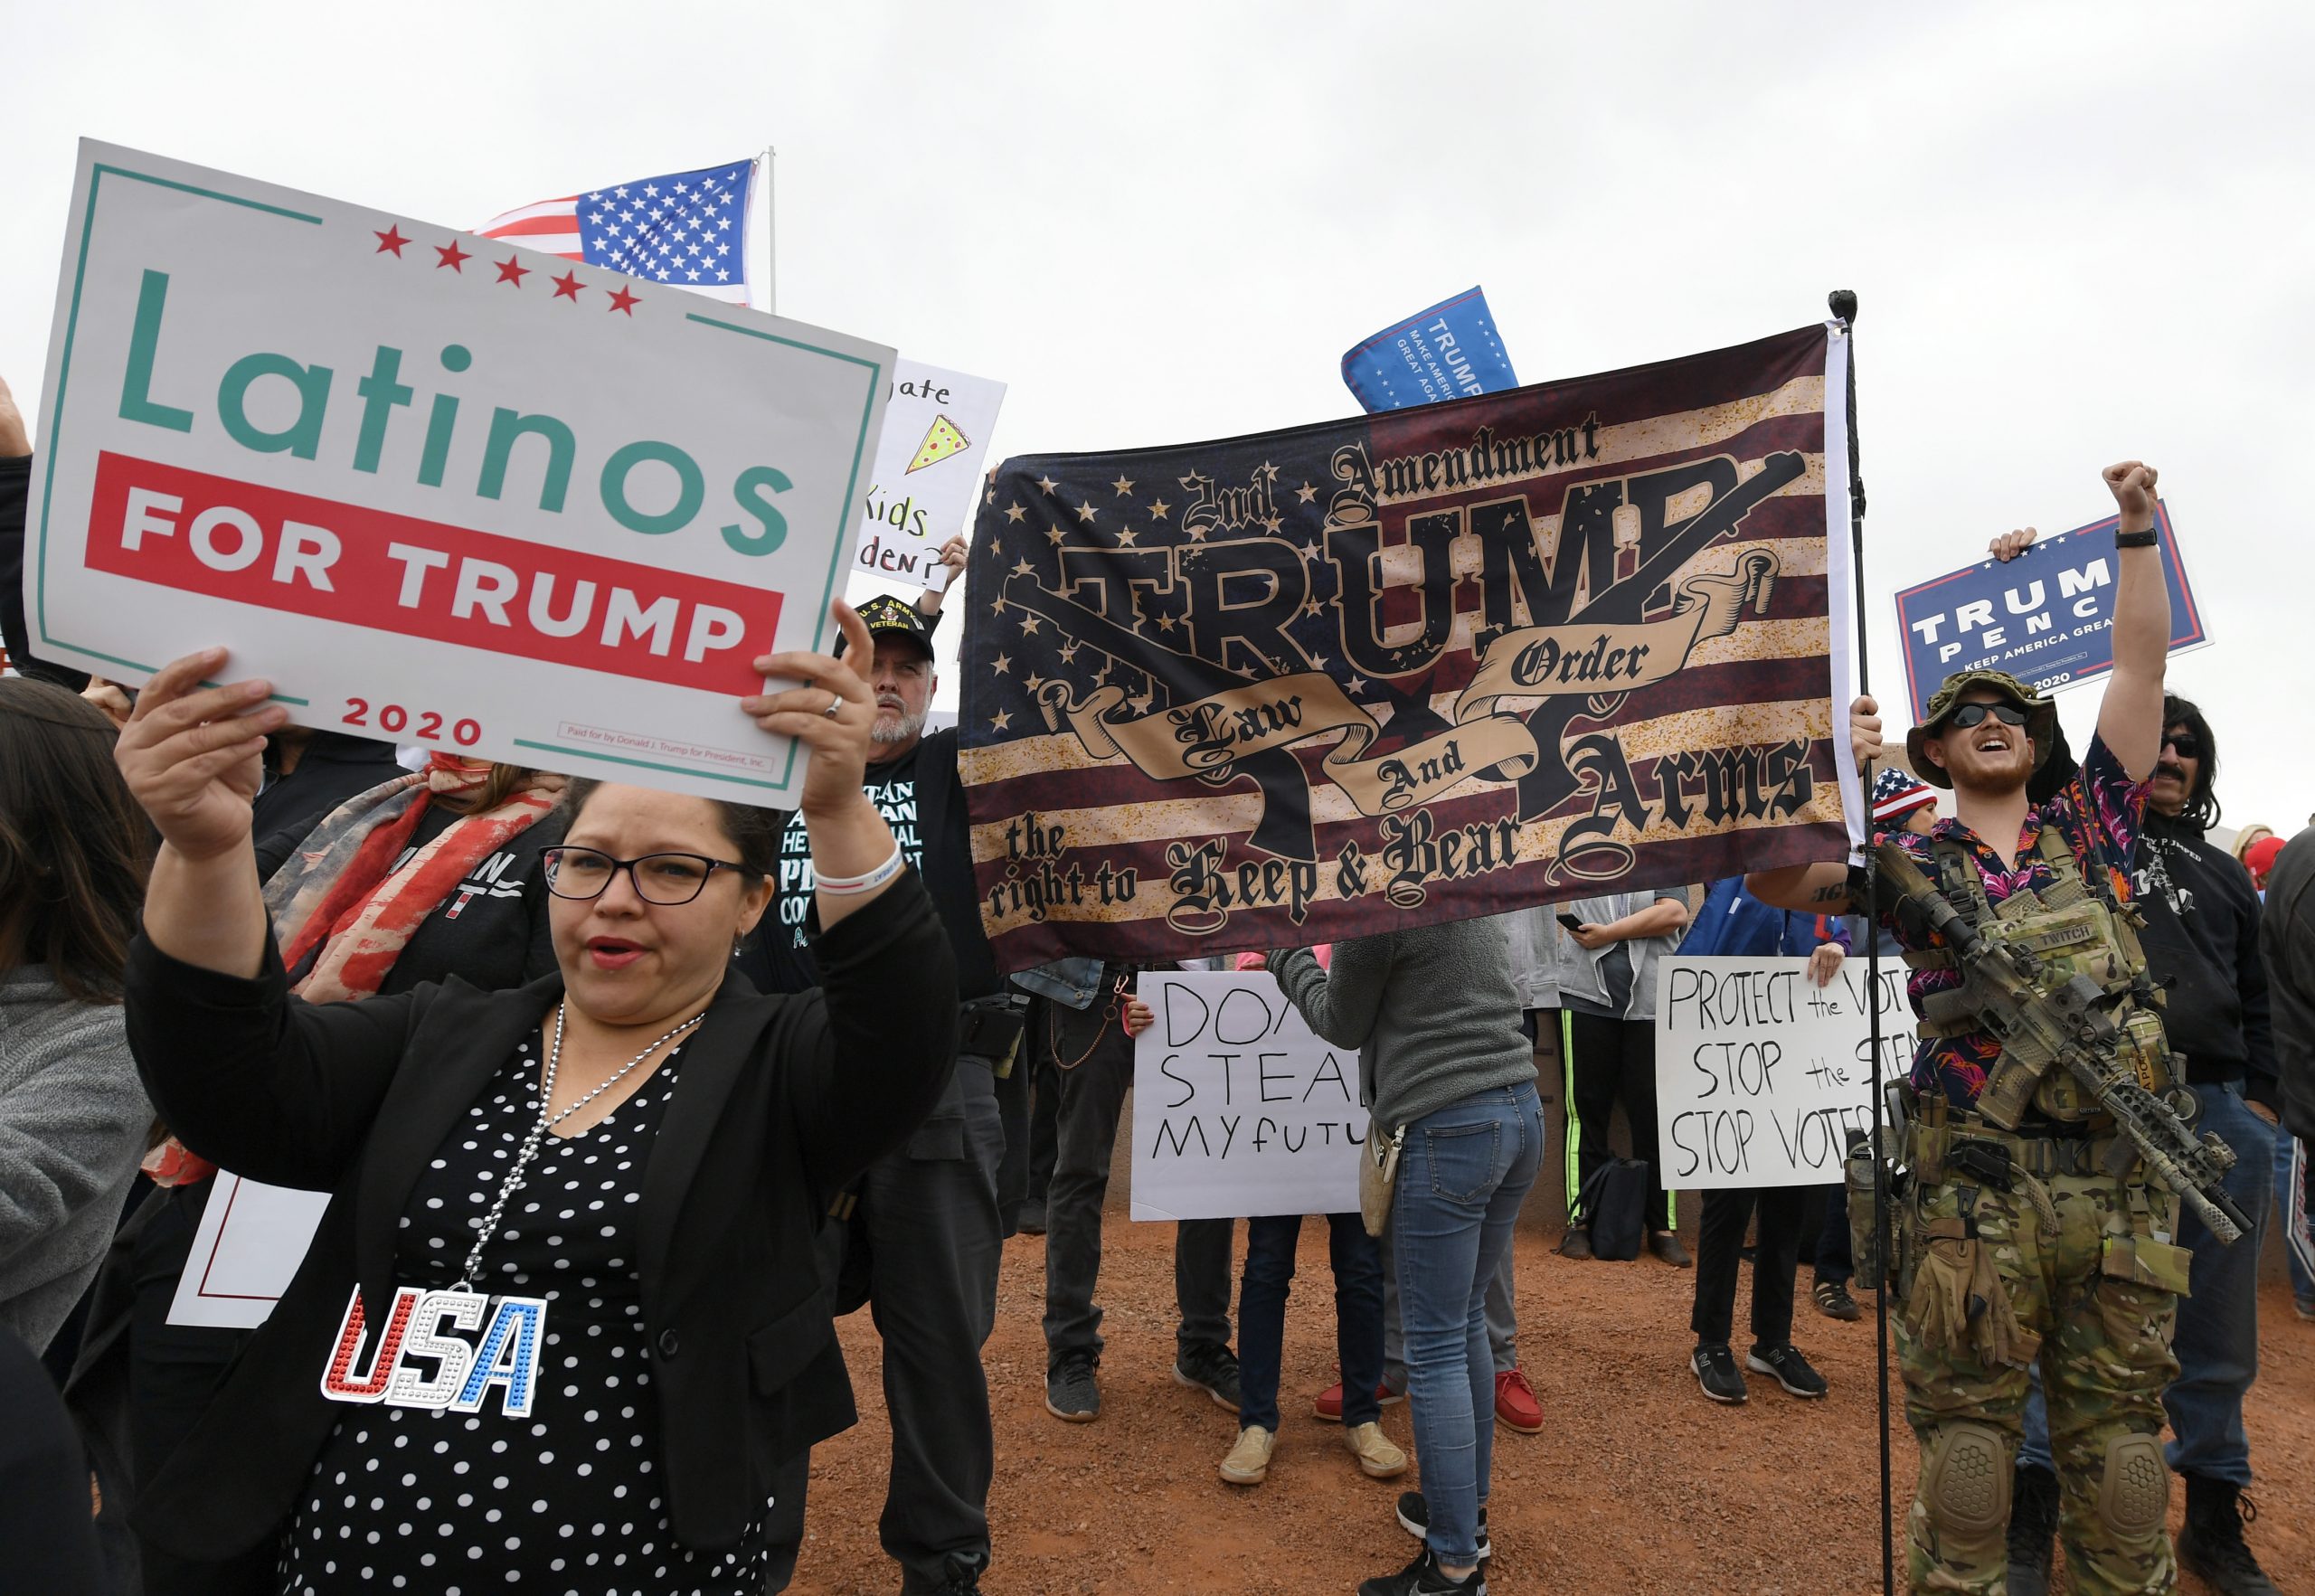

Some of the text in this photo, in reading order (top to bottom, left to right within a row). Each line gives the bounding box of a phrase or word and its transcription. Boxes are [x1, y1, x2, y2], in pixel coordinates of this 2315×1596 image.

[1397, 338, 1440, 402] GREAT AGA
[1408, 329, 1433, 362] MAKE
[1428, 317, 1484, 396] TRUMP
[118, 268, 795, 557] Latinos
[1177, 411, 1602, 534] 2nd Amendment
[119, 486, 747, 665] FOR TRUMP
[1056, 450, 1743, 710] TRUMP
[1912, 555, 2116, 646] TRUM
[869, 620, 910, 630] VETERAN
[887, 600, 916, 619] ARMY
[1509, 634, 1652, 686] Order
[1964, 655, 2000, 673] KEEP
[2004, 633, 2069, 660] AMERICA
[2073, 616, 2114, 637] GREA
[2034, 672, 2072, 691] 2020
[341, 697, 482, 748] 2020
[567, 725, 588, 738] Paid
[589, 728, 603, 741] for
[603, 732, 616, 745] by
[617, 733, 650, 750] Donald
[659, 741, 688, 757] Trump
[689, 746, 704, 758] for
[704, 749, 748, 767] President,
[1167, 693, 1305, 770] Law
[1376, 738, 1467, 812] And
[987, 723, 1812, 936] right to Keep & Bear Arms
[1005, 809, 1067, 863] the
[2039, 925, 2091, 947] TWITCH
[1668, 967, 1801, 1031] PROTECT
[1807, 988, 1843, 1019] the
[1693, 1040, 1782, 1100] STOP
[1805, 1056, 1850, 1091] the
[2142, 1081, 2152, 1091] A
[1152, 1114, 1241, 1160] MY
[1671, 1108, 1755, 1177] STOP
[319, 1281, 549, 1419] USA
